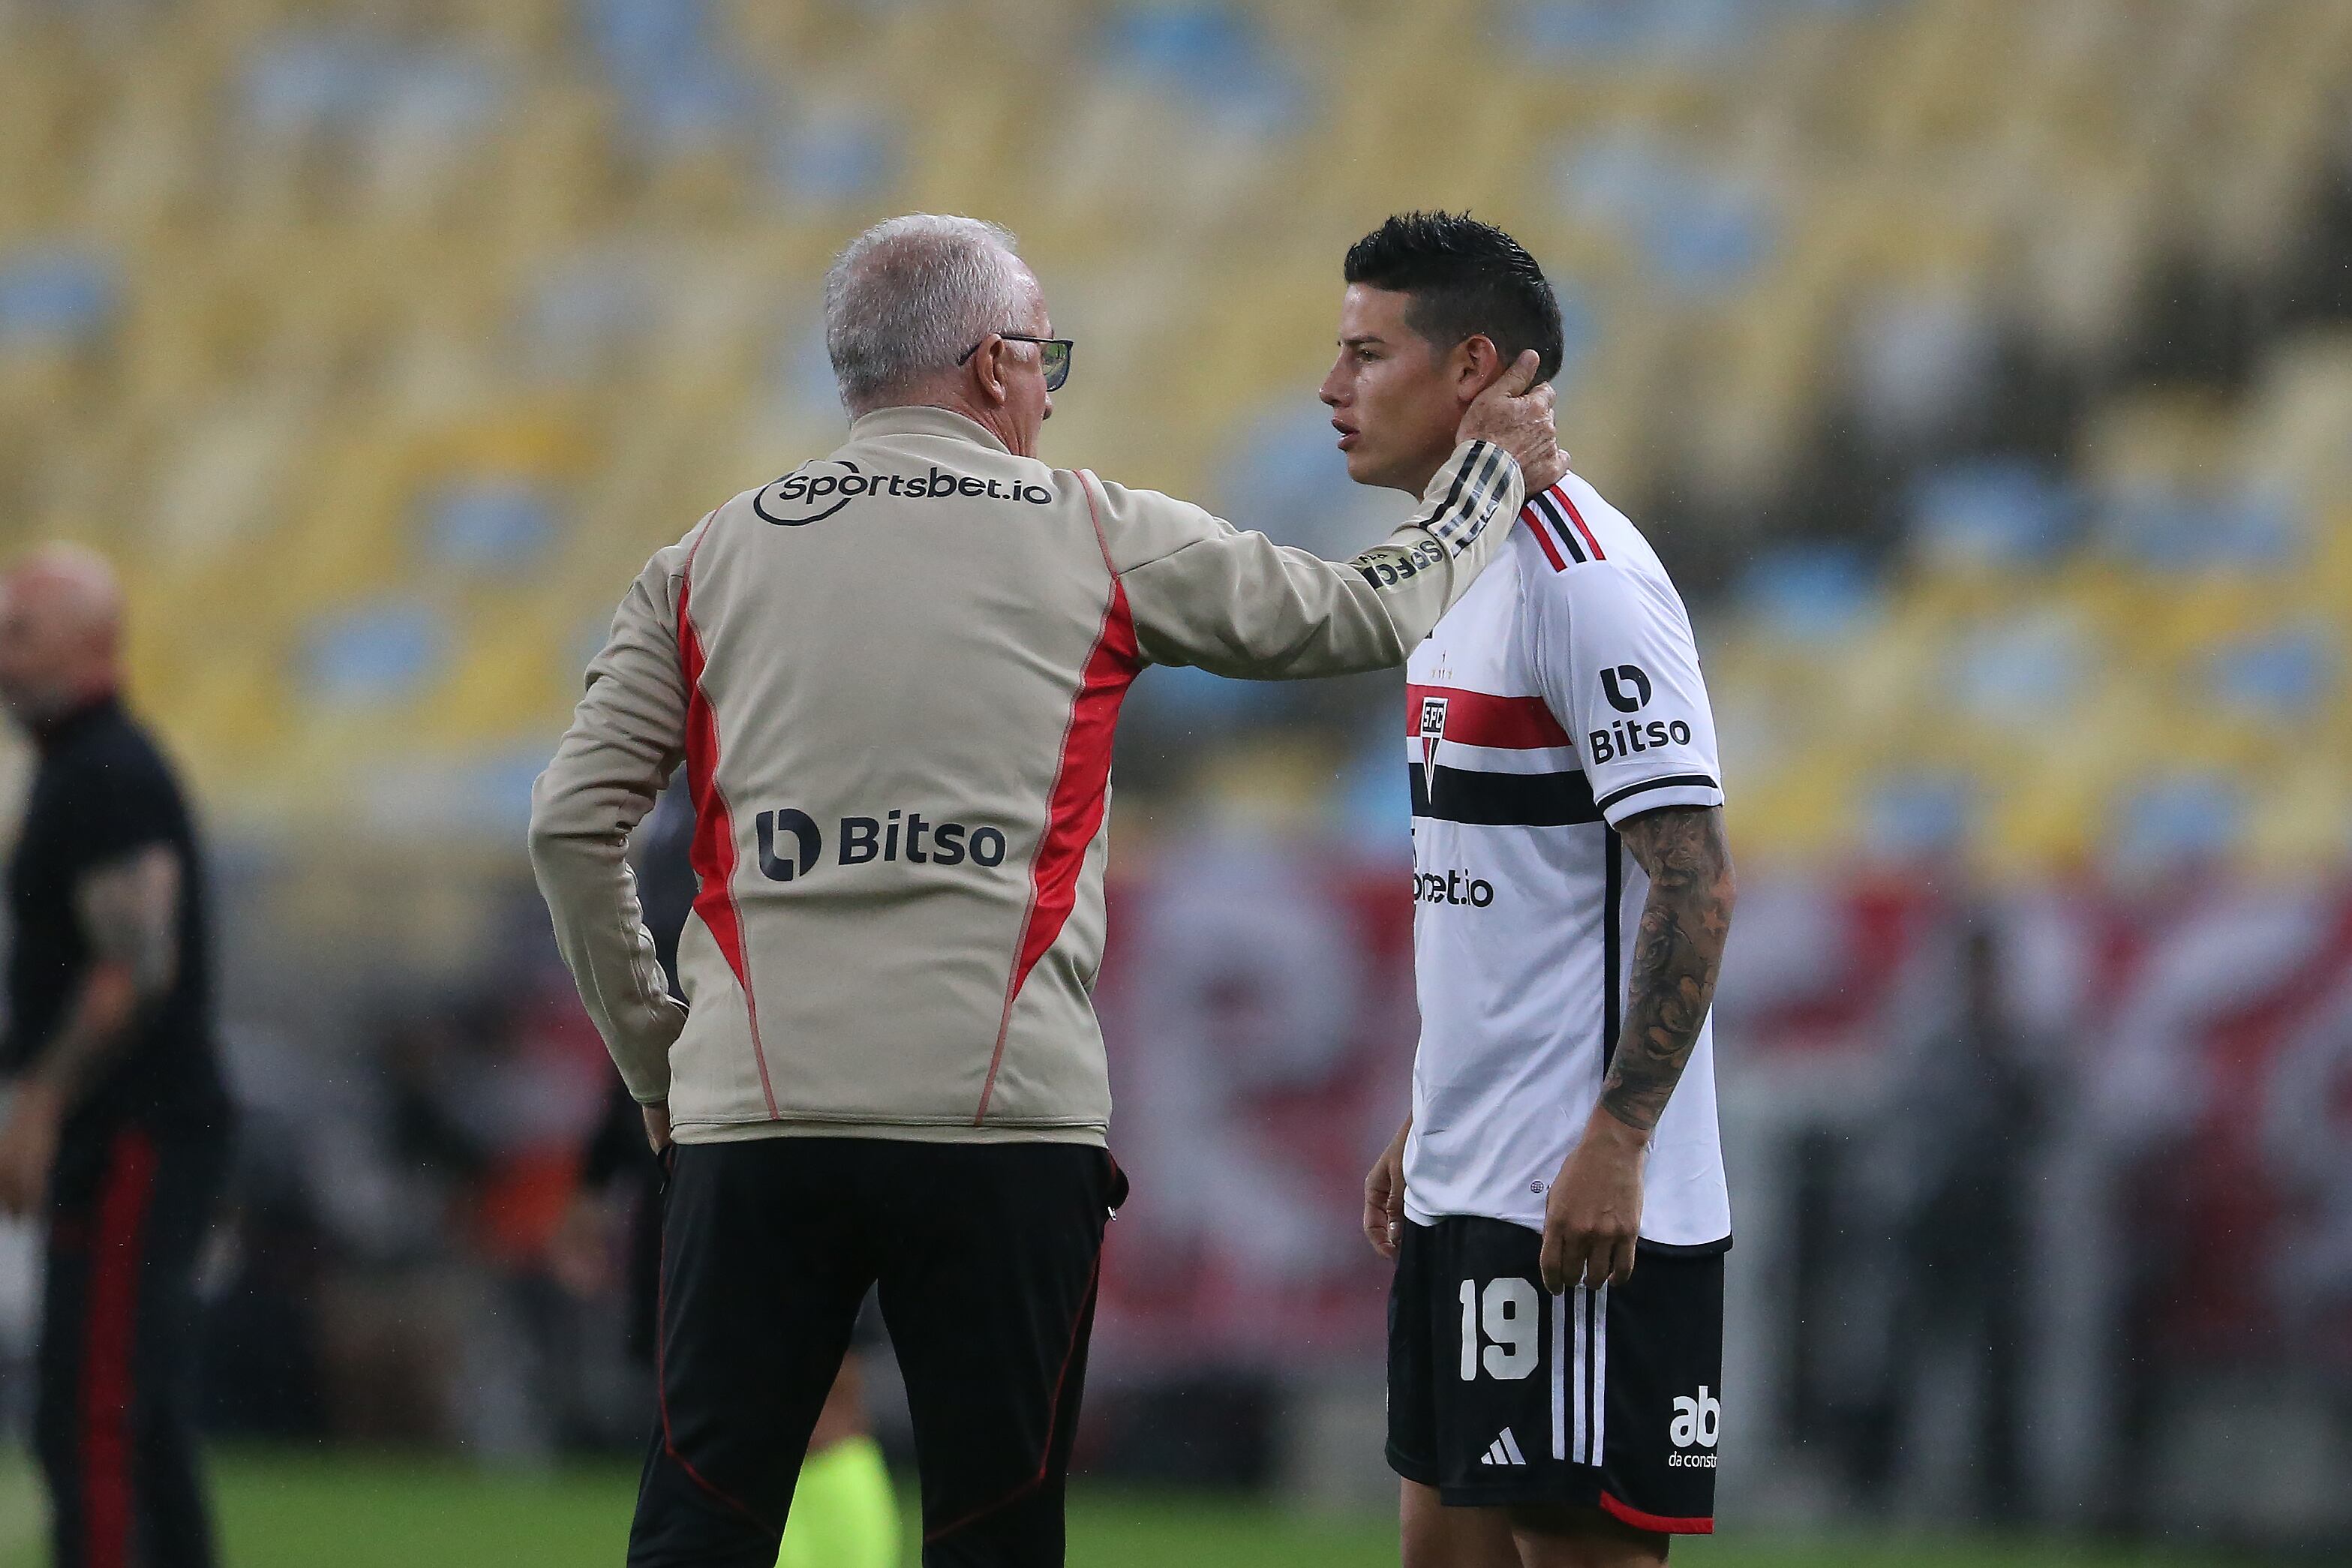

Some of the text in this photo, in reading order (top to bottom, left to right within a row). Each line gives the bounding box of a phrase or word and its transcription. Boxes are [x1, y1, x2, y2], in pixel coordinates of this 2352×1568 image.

[779, 467, 1051, 505] sportsbet.io
[1589, 719, 1690, 765] Bitso
[838, 810, 1006, 867] Bitso
[1459, 1278, 1539, 1381] 19
